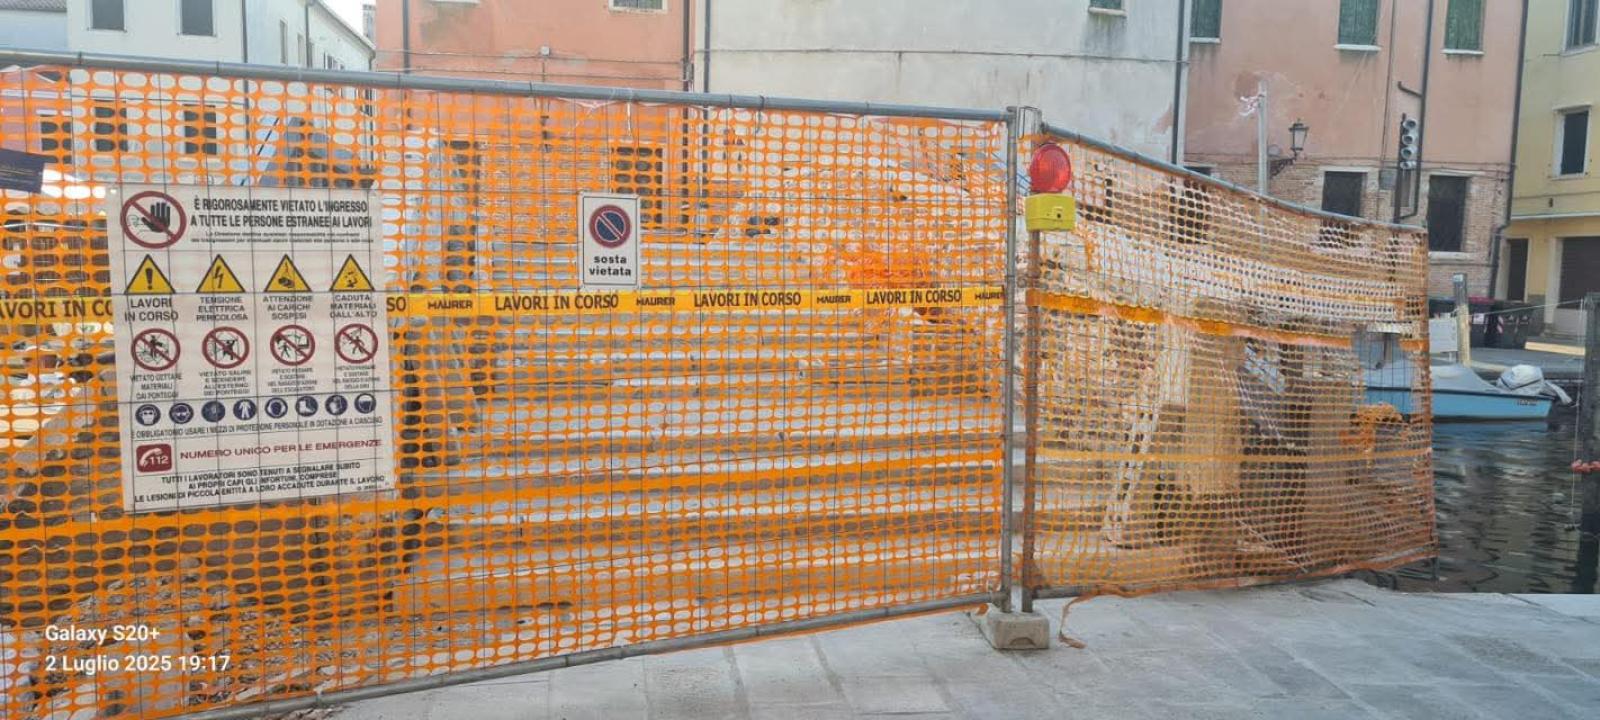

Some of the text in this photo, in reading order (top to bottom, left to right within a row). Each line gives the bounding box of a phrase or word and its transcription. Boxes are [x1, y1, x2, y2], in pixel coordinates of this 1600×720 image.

[194, 194, 368, 213] È RIGOROSAMENTE VIETATO L'INGRESSO
[190, 214, 372, 228] A TUTTE LE PERSONE ESTRANEE AI LAVORI
[593, 254, 627, 264] sosta
[589, 265, 632, 277] vietata
[130, 297, 172, 308] LAVORI
[200, 296, 242, 304] TENSIONE
[262, 295, 313, 303] ATTENZIONE
[427, 299, 473, 310] MAURER
[495, 294, 550, 311] LAVORI
[554, 294, 571, 310] IN
[574, 293, 619, 310] CORSO
[636, 296, 676, 306] MAURER
[693, 292, 740, 308] LAVORI
[744, 292, 759, 307] IN
[761, 291, 802, 307] CORSO
[816, 295, 852, 304] MAURER
[866, 290, 907, 305] LAVORI
[910, 290, 923, 304] IN
[925, 289, 962, 303] CORSO
[62, 299, 86, 318] IN
[198, 305, 245, 313] ELETTRICA
[277, 303, 311, 311] CARICHI
[330, 302, 376, 310] MATERIALI
[124, 310, 179, 322] IN CORSO
[196, 313, 249, 322] PERICOLOSA
[271, 312, 307, 320] SOSPESI
[136, 428, 183, 438] OBBLIGATORIO
[180, 439, 383, 459] NUMERO UNICO PER LE EMERGENZE
[150, 455, 169, 465] 112
[161, 475, 182, 484] TUTTI
[188, 470, 236, 482] LAVORATORI
[237, 469, 258, 478] SONO
[259, 467, 285, 476] TENUTI
[286, 466, 291, 474] A
[292, 464, 334, 473] SEGNALARE
[336, 461, 361, 470] SUBITO
[134, 495, 144, 503] LE
[146, 492, 176, 502] LESIONI
[177, 491, 186, 499] DI
[187, 487, 220, 498] PICCOLA
[255, 484, 276, 492] LORO
[277, 480, 315, 491] ACCADUTE
[316, 477, 348, 487] DURANTE
[357, 475, 385, 485] LAVORO
[197, 480, 226, 489] PROPRI
[226, 479, 244, 487] CAPI
